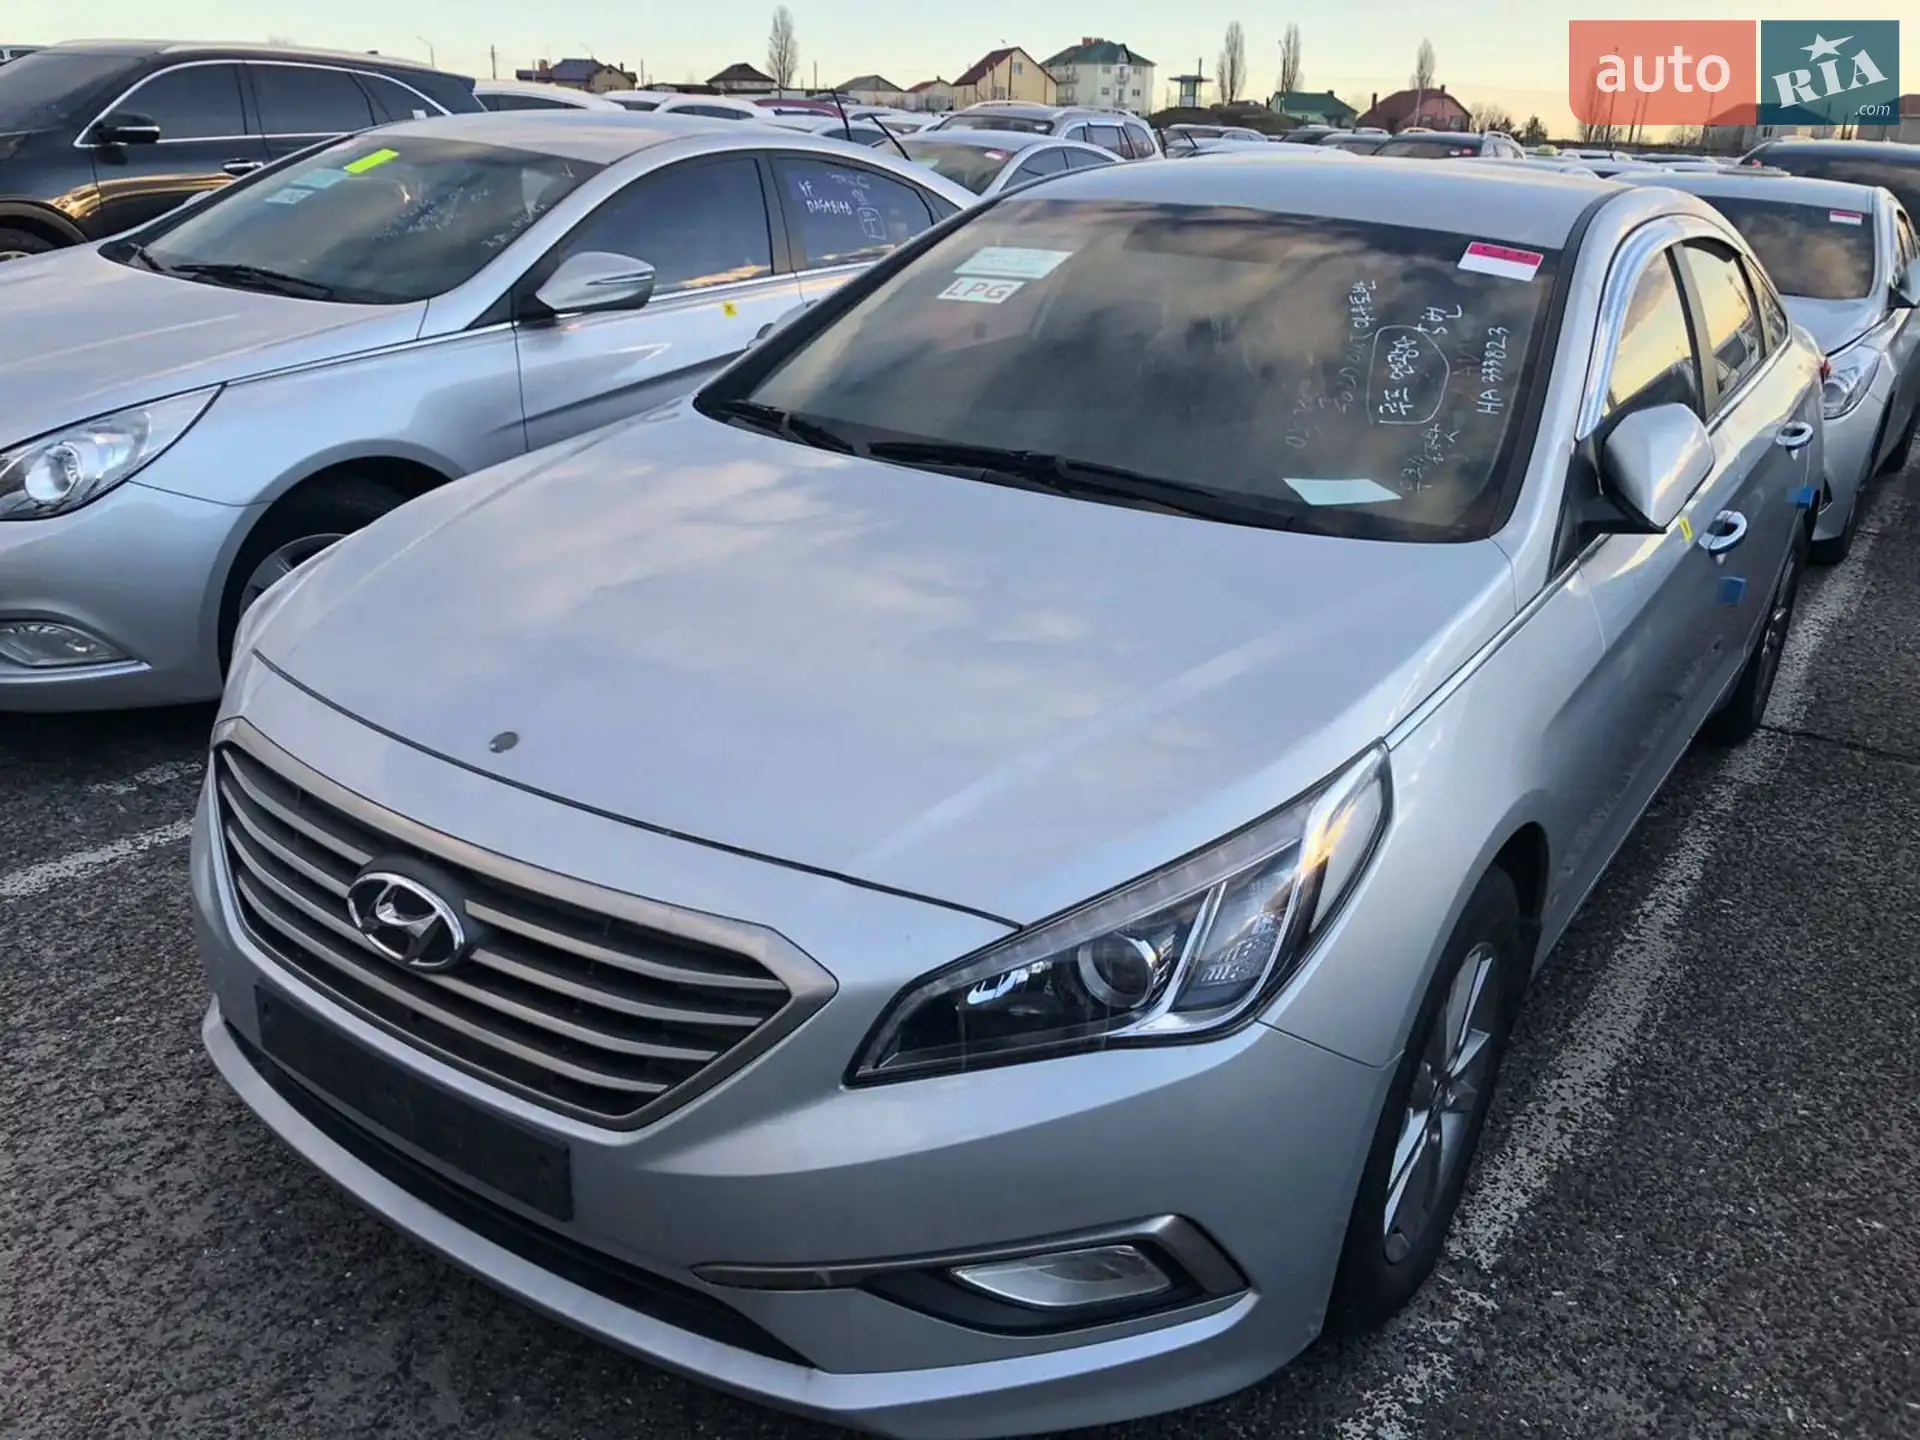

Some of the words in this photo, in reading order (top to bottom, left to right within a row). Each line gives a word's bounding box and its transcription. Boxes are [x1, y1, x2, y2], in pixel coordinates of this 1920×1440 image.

[945, 281, 1014, 300] LPG
[1480, 326, 1511, 384] 333823
[1477, 389, 1505, 415] HA
